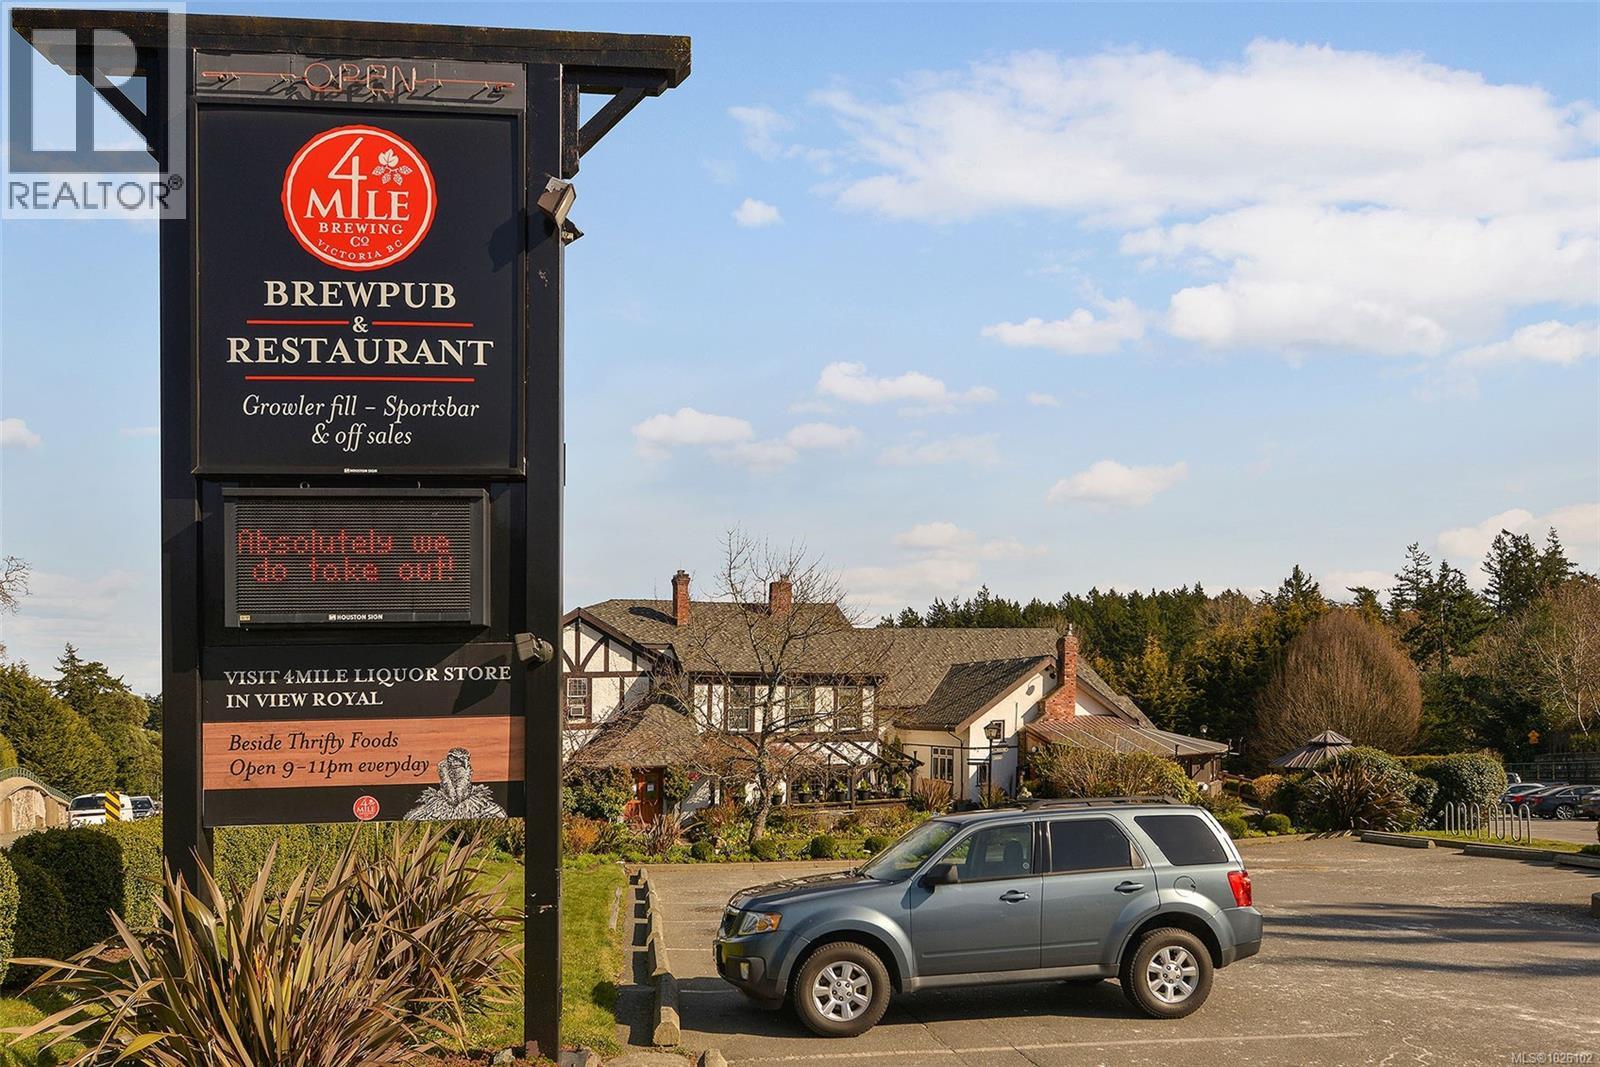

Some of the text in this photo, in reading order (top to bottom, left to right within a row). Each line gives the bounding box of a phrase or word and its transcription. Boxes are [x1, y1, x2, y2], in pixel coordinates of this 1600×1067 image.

[304, 63, 416, 93] OPEN
[328, 137, 367, 202] 4
[304, 188, 410, 222] MILE
[319, 222, 403, 235] BREWING
[317, 239, 403, 260] VICTORIA BC
[264, 280, 457, 309] BREWPUB
[352, 316, 369, 333] &
[226, 337, 494, 366] RESTAURANT
[242, 394, 325, 417] Growler
[327, 394, 357, 424] fill
[383, 396, 480, 424] Sportsbar
[311, 423, 412, 452] & off sales
[236, 528, 451, 556] Absolutely we
[251, 556, 289, 583] do
[309, 556, 380, 583] take
[224, 665, 512, 688] VISIT 4MILE LIQUOR STORE
[226, 691, 384, 709] IN VIEW ROYAL
[228, 731, 399, 755] Beside Thrifty Foods
[230, 758, 275, 781] Open
[358, 754, 430, 777] everyday
